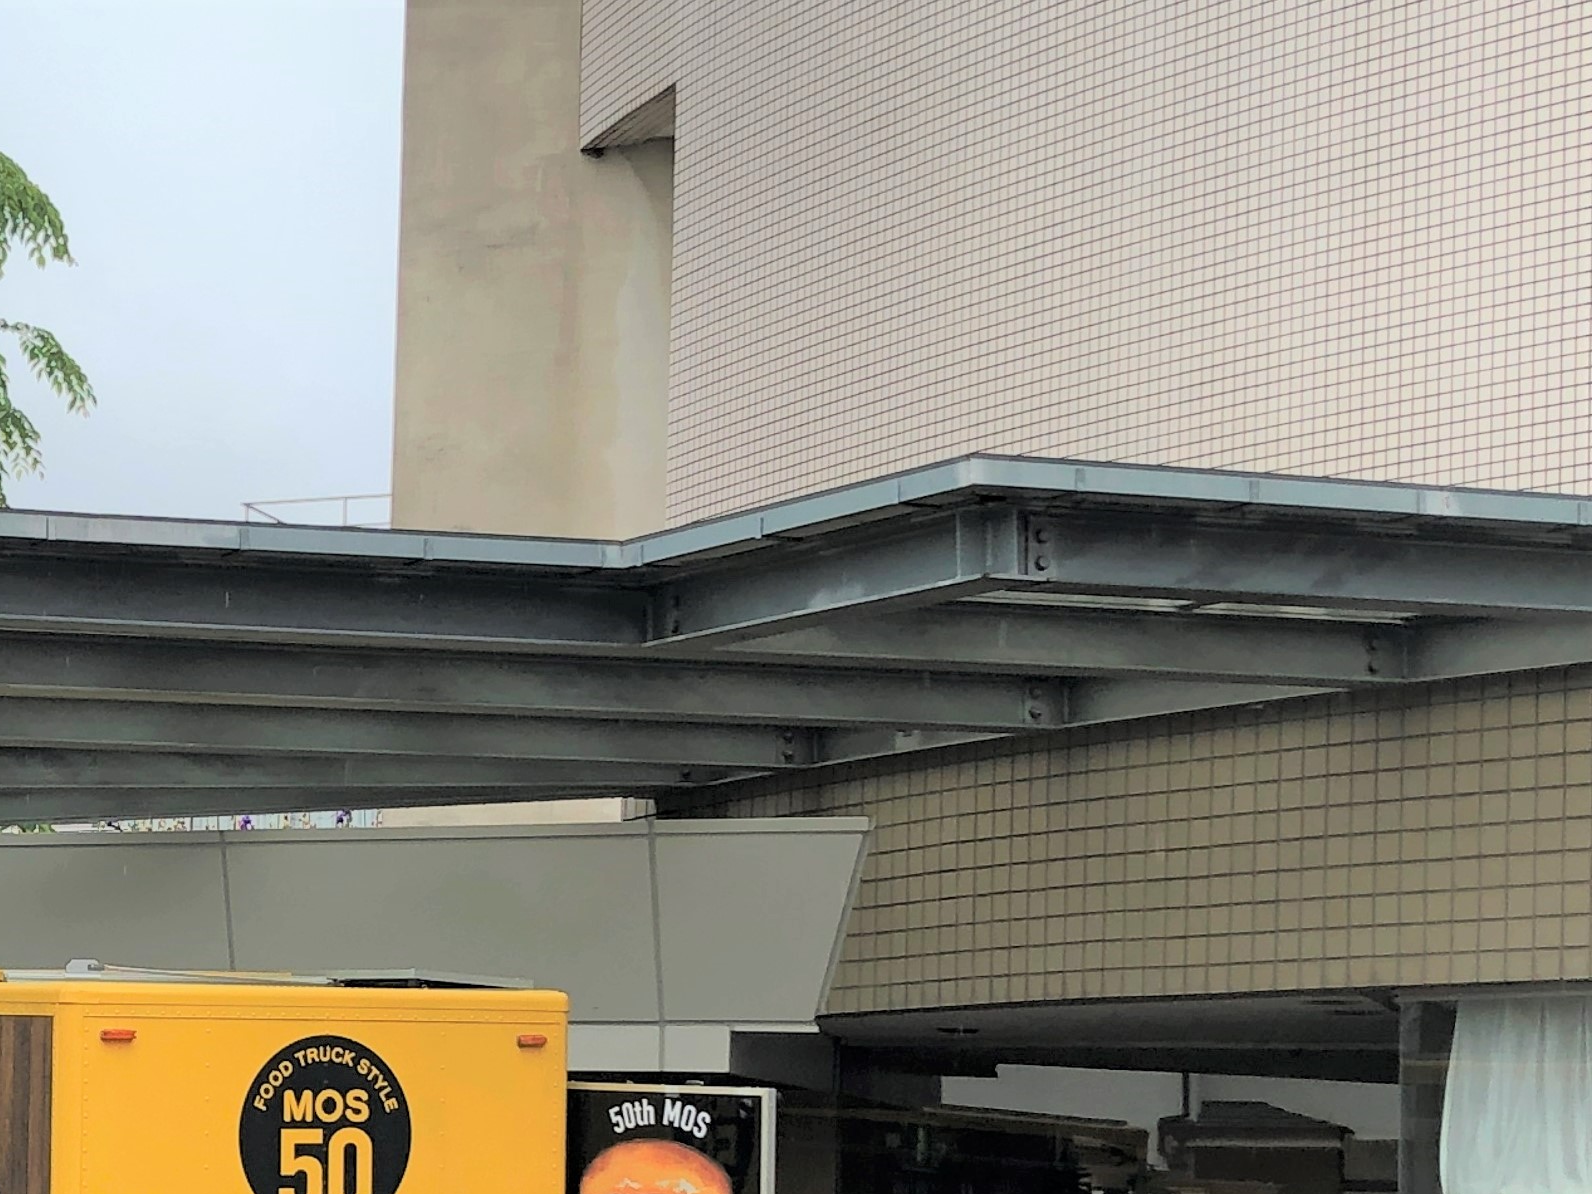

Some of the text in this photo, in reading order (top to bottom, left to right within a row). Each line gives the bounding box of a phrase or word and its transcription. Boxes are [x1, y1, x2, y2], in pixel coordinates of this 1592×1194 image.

[253, 1045, 399, 1113] FOOD TRUCK STYLE
[283, 1088, 370, 1123] MOS
[609, 1098, 711, 1139] 50th MOS
